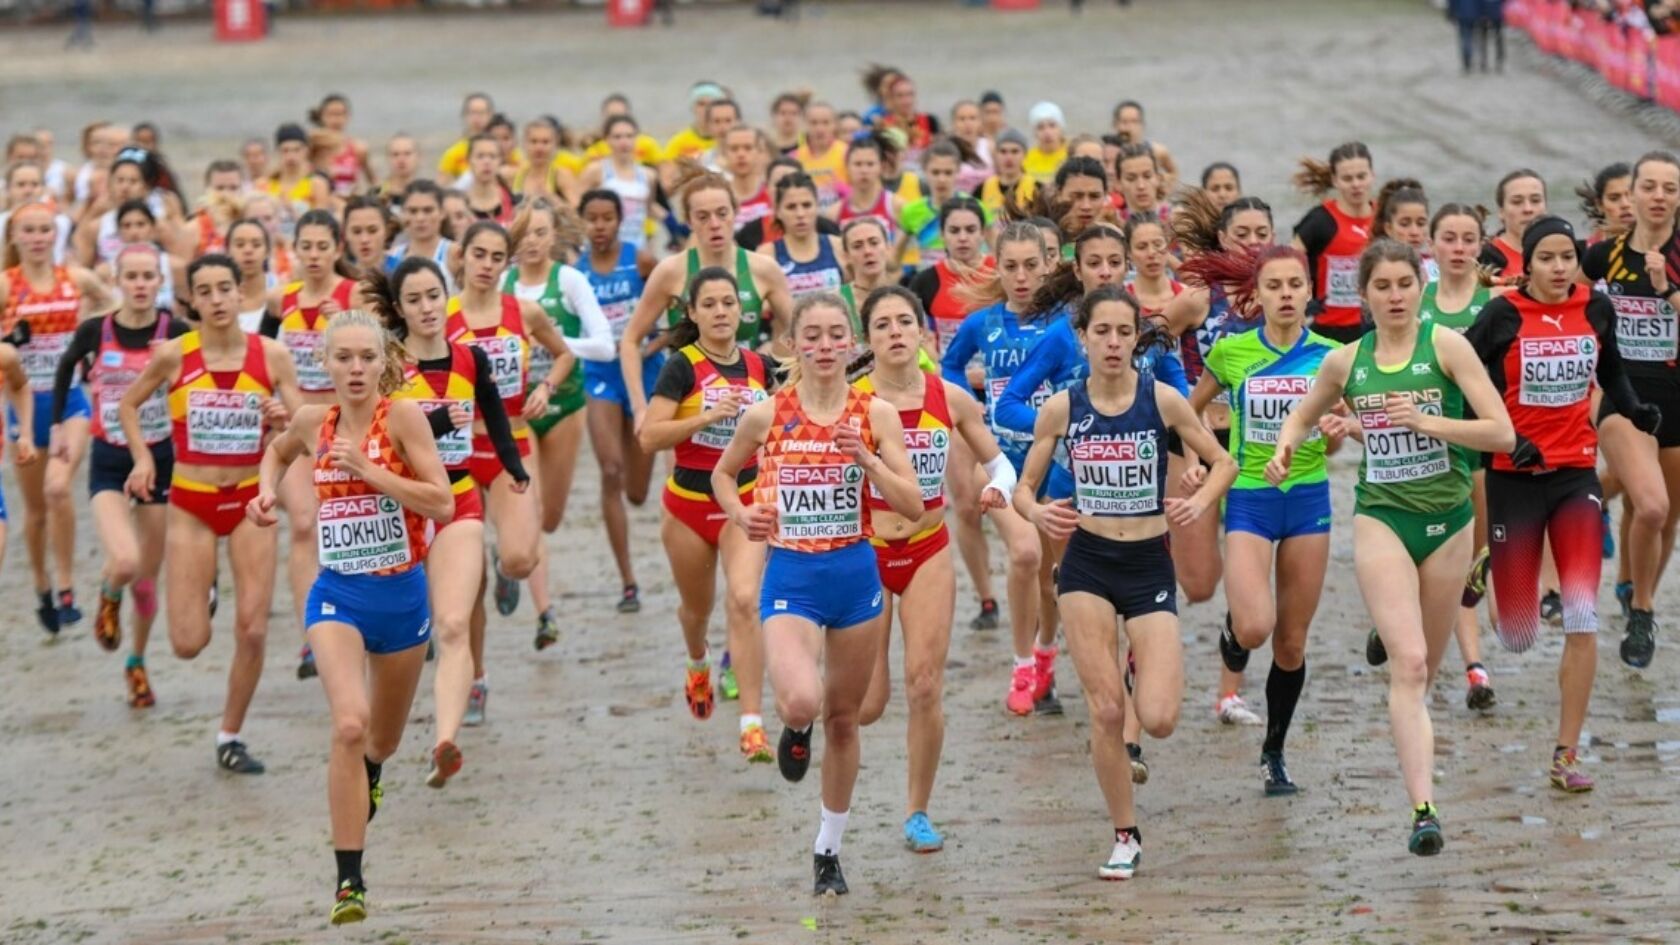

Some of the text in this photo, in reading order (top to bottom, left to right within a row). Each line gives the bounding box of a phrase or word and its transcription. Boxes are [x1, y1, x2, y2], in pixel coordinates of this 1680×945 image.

[1617, 316, 1674, 338] RIEST
[1525, 341, 1578, 355] SPAR
[1525, 359, 1593, 382] SCLABAS
[1249, 379, 1306, 392] SPAR
[190, 392, 243, 407] SPAR
[904, 433, 930, 447] AR
[1074, 444, 1134, 459] SPAR
[912, 452, 945, 474] ARDO
[1372, 460, 1446, 480] TILBURG 2018
[780, 468, 841, 483] SPAR
[1079, 463, 1152, 488] JULIEN
[781, 487, 858, 512] VAN ES
[1081, 498, 1154, 511] TILBURG 2018
[320, 499, 377, 519] SPAR
[322, 516, 404, 549] BLOKHUIS
[784, 523, 858, 536] TILBURG 2018
[379, 553, 406, 567] 2018
